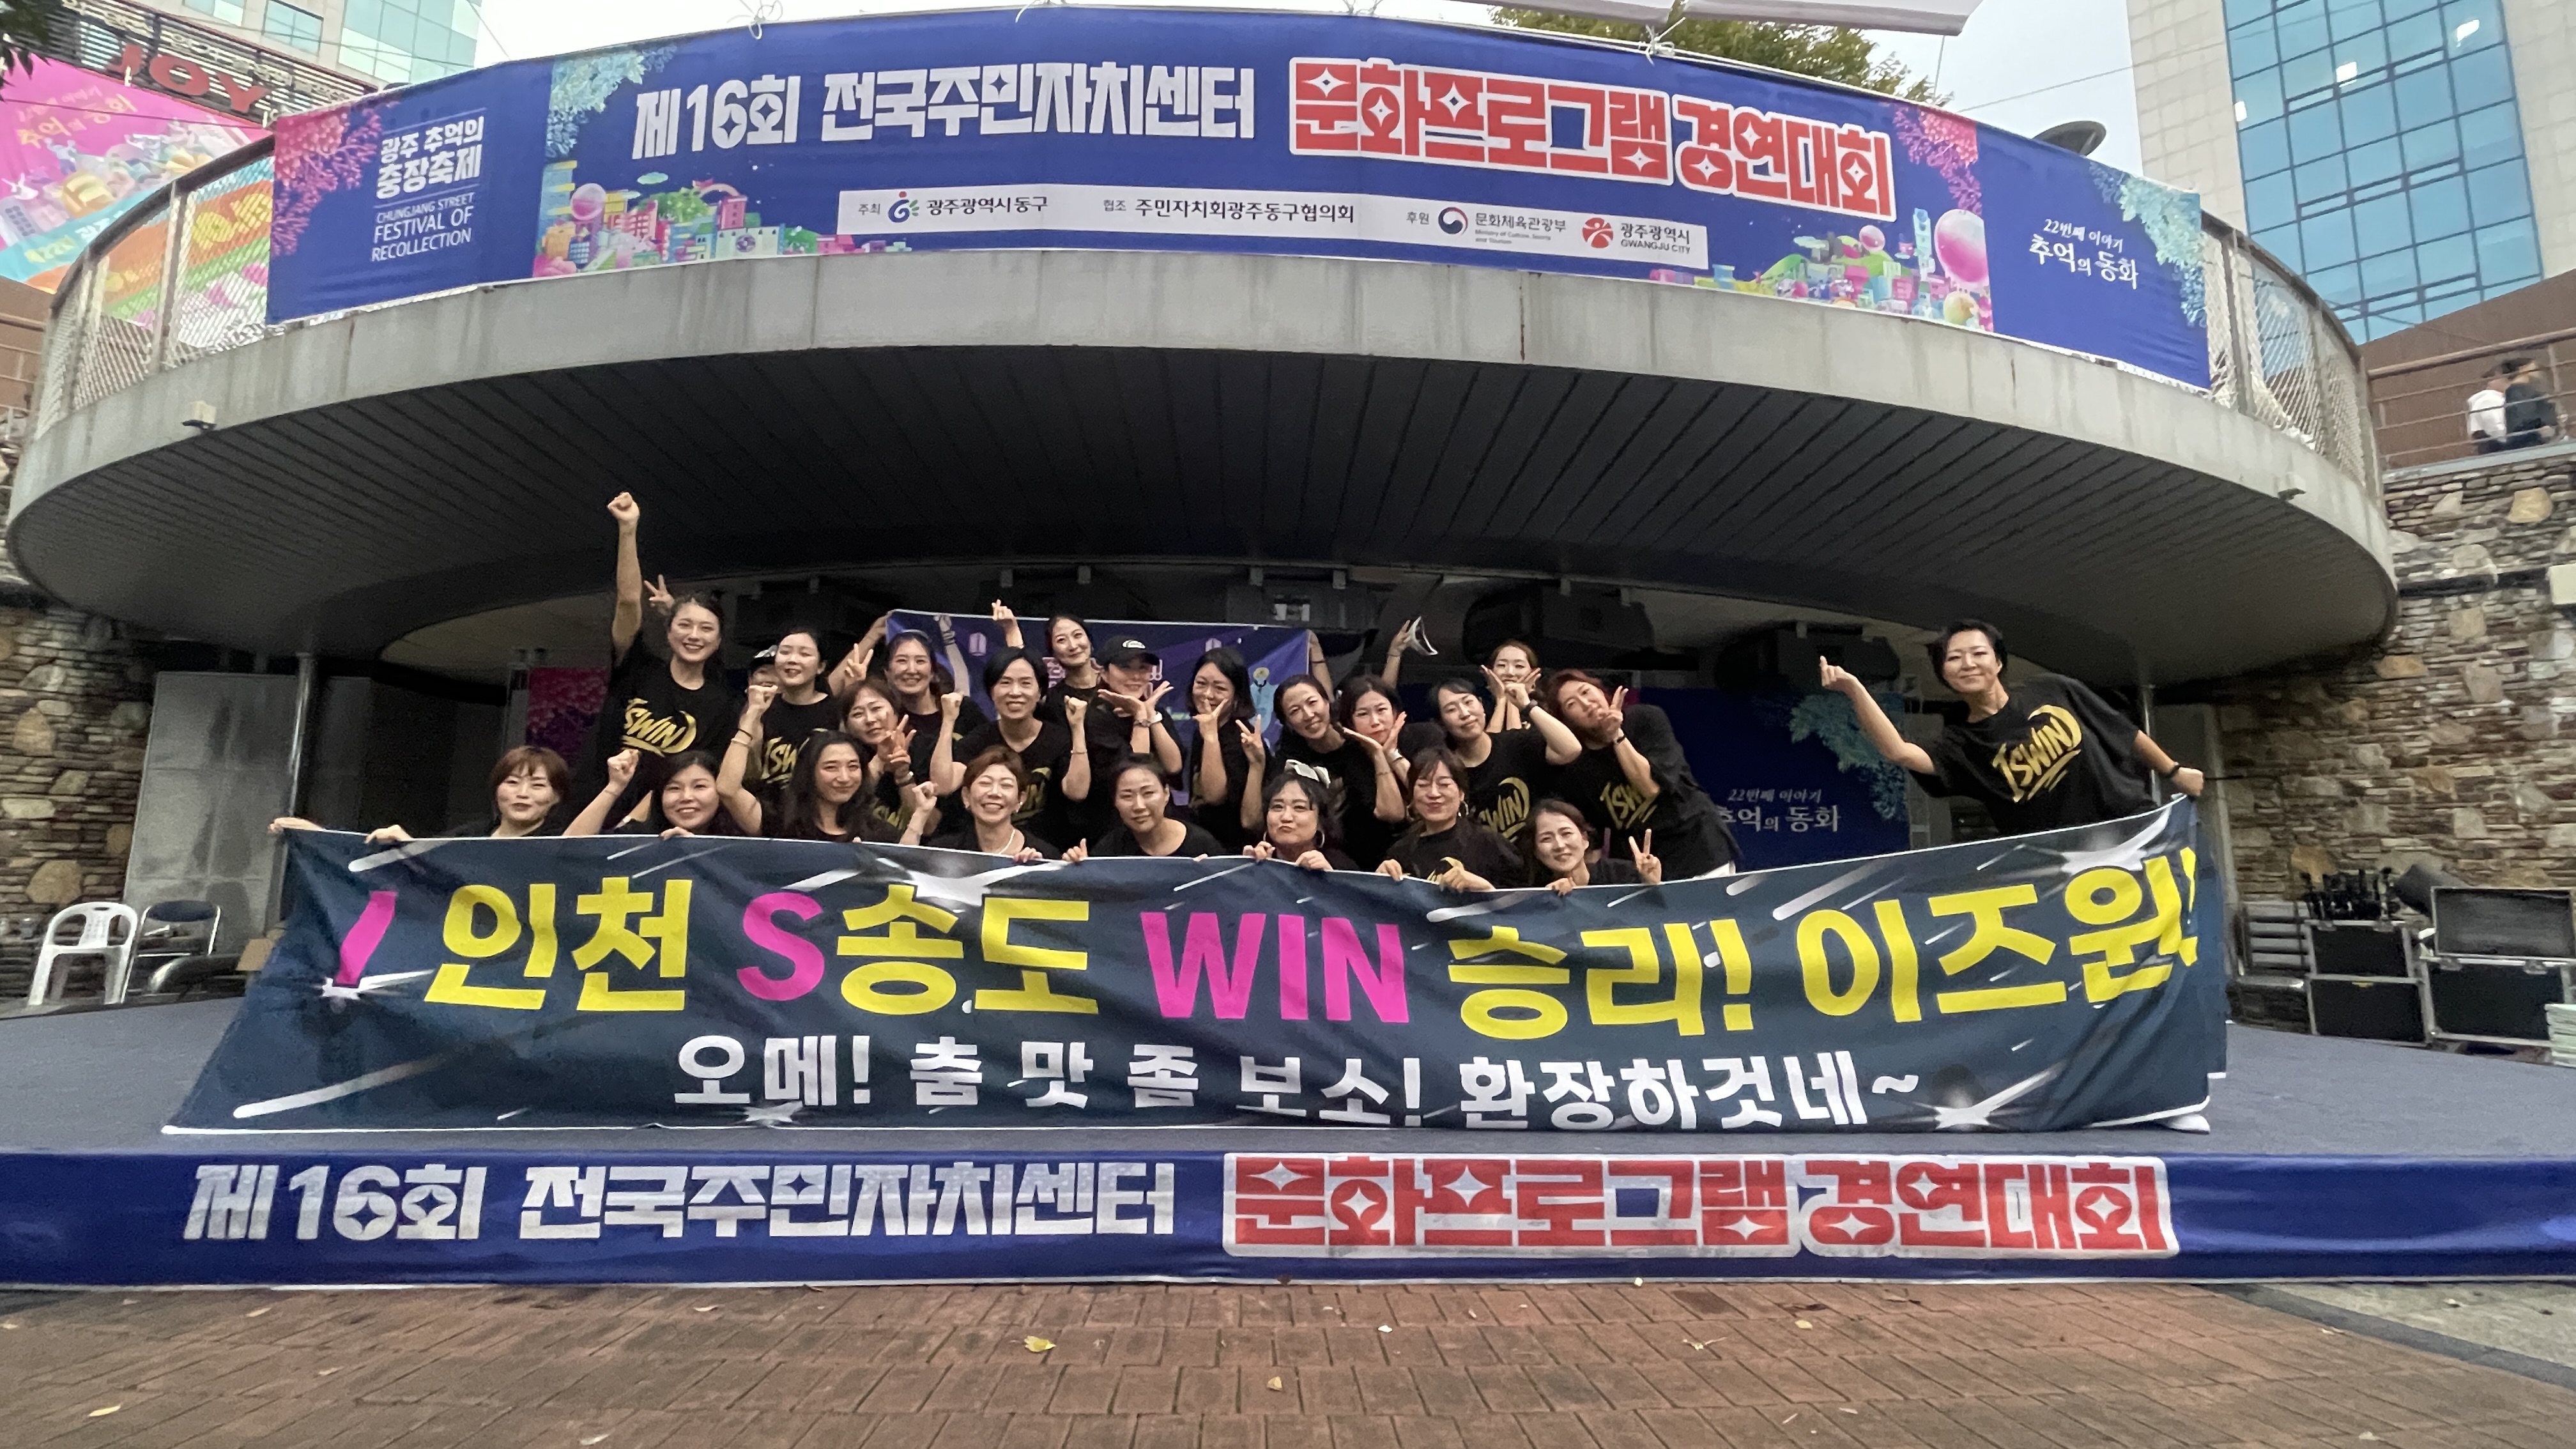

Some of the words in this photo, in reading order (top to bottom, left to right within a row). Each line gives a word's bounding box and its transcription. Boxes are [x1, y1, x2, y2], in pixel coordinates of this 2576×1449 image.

[104, 43, 269, 114] JOY
[381, 132, 419, 164] 광주
[424, 116, 484, 153] 추억의
[631, 74, 801, 159] 제16회
[821, 61, 1255, 142] 전국주민자치센터
[1290, 57, 1674, 185] 문화프로그램
[1673, 94, 1897, 222] 경연대회
[376, 144, 482, 199] 충장축제
[374, 213, 445, 244] FESTIVAL
[450, 206, 474, 226] OF
[377, 201, 436, 224] CHUNGJANG
[438, 192, 475, 211] STREET
[858, 203, 880, 216] 주최
[1103, 199, 1127, 212] 협조
[1135, 198, 1354, 224] 주민자치회광주동구협의회
[1406, 211, 1430, 225] 후원
[1475, 212, 1567, 233] 문화체육관광부
[371, 227, 471, 262] RECOLLECTION
[1620, 223, 1690, 245] 광주광역시
[1620, 238, 1670, 251] GWANGJU
[1671, 244, 1690, 254] CITY
[2043, 218, 2085, 241] 22번째
[2089, 231, 2124, 254] 이야기
[2029, 233, 2092, 277] 추억의
[2095, 250, 2139, 290] 동화
[1779, 788, 1822, 803] 이야기
[1785, 804, 1841, 832] 동화
[424, 876, 693, 1011] 인천
[1140, 912, 1409, 1023] WIN
[1448, 919, 1754, 1041] 승리!
[1797, 847, 2198, 1023] 이즈원!
[674, 1035, 870, 1107] 오메!
[910, 1036, 983, 1107] 춤
[1022, 1041, 1094, 1110] 맛
[1126, 1043, 1199, 1109] 좀
[1236, 1055, 1422, 1127] 보소!
[1459, 1050, 1919, 1130] 환장하것네~
[183, 1163, 487, 1241] 제16회
[519, 1162, 1174, 1240] 전국주민자치센터
[1223, 1153, 1799, 1259] 문화프로그램
[1799, 1154, 2180, 1259] 경연대회
